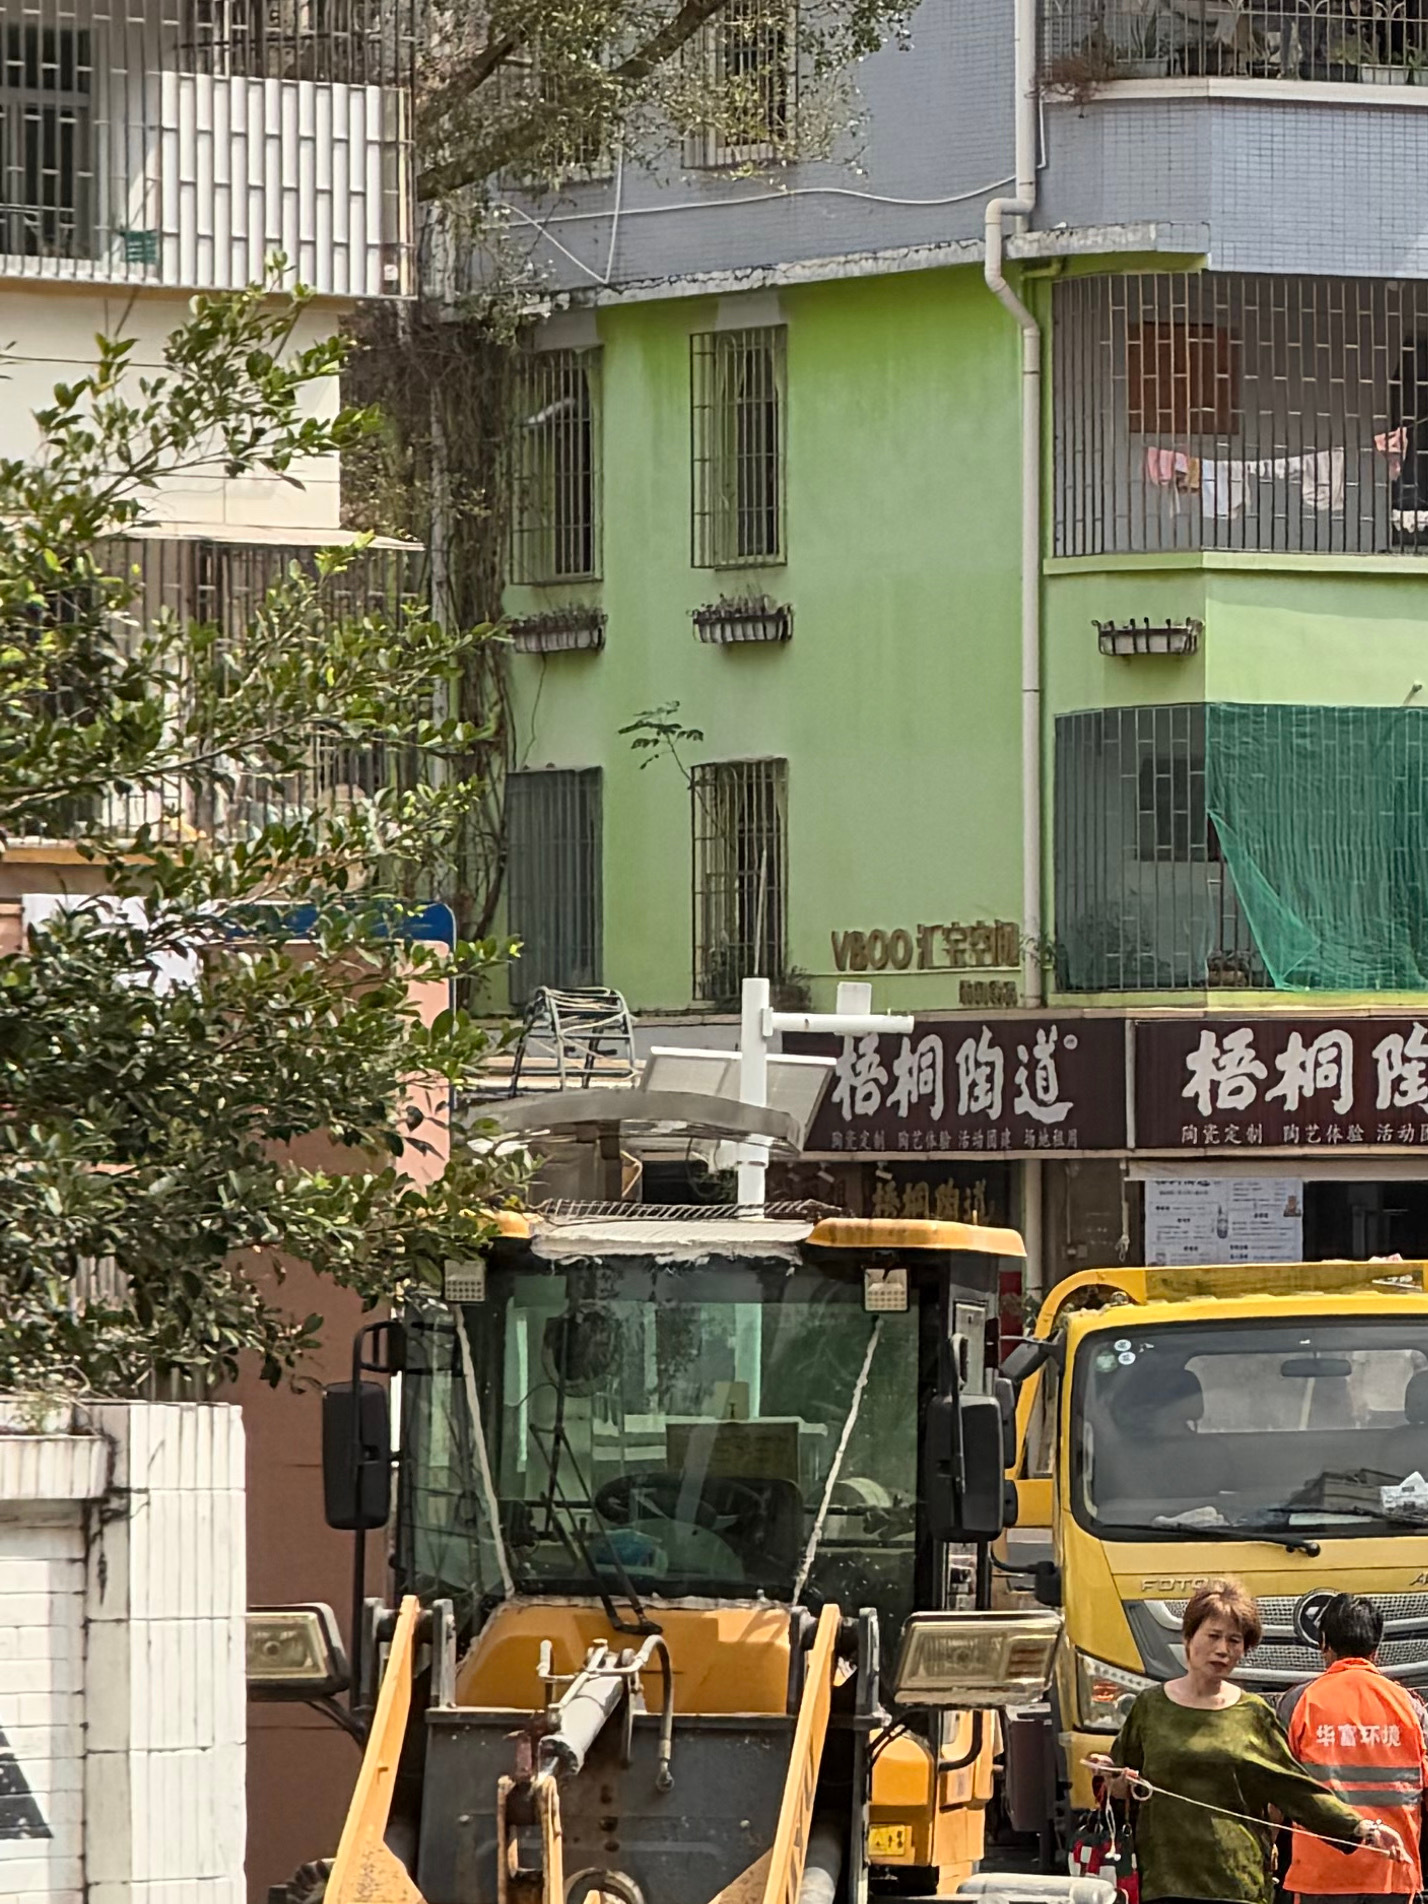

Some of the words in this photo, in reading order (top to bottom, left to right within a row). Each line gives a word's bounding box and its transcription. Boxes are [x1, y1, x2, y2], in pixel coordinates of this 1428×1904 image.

[831, 1024, 1074, 1124] 梧桐陶道
[1181, 1123, 1263, 1145] 陶瓷定制
[1283, 1123, 1365, 1145] 陶艺体验
[1316, 1724, 1401, 1747] 华富环境
